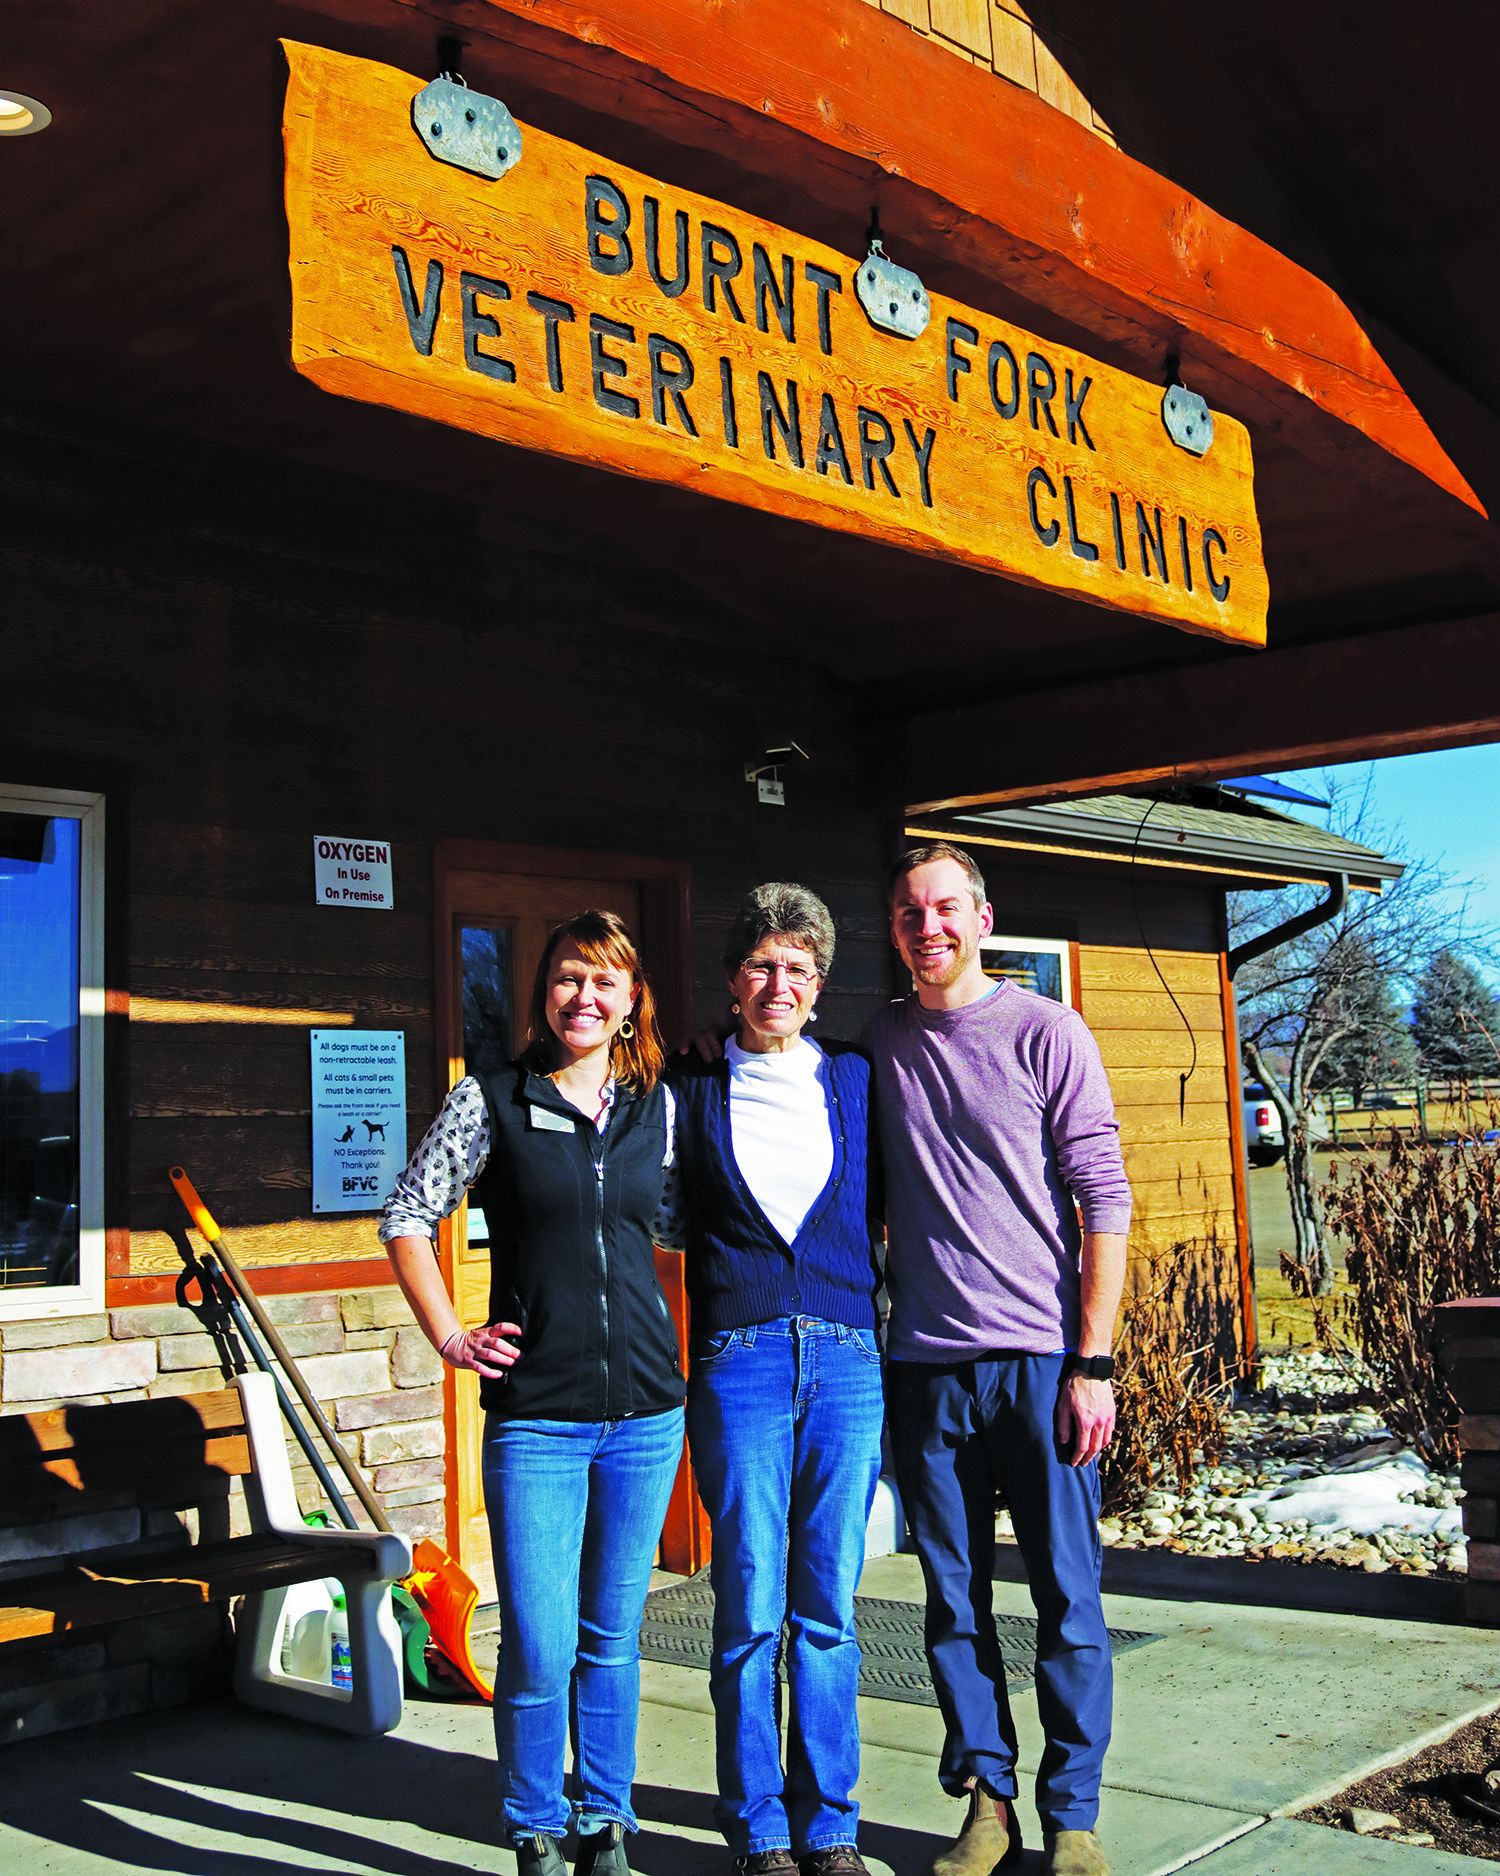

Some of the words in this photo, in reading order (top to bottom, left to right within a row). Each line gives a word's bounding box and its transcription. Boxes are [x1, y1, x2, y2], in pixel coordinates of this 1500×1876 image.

[585, 174, 842, 356] BURNT
[946, 316, 1096, 452] FORK
[391, 244, 936, 509] VETERINARY
[1027, 466, 1230, 602] CLINIC
[318, 841, 388, 864] OXYGEN
[337, 867, 348, 879] In
[350, 868, 371, 881] Use
[325, 887, 340, 899] On
[342, 888, 384, 902] Premise
[320, 1043, 330, 1051] All
[331, 1043, 349, 1052] dogs
[370, 1043, 379, 1051] be
[319, 1056, 376, 1064] non-retractable
[377, 1057, 397, 1065] leash.
[378, 1074, 394, 1082] pets
[345, 1087, 355, 1095] be
[364, 1087, 392, 1095] carriers.
[347, 1148, 386, 1157] Exceptions.
[364, 1161, 380, 1170] you!
[342, 1176, 378, 1191] BFVC
